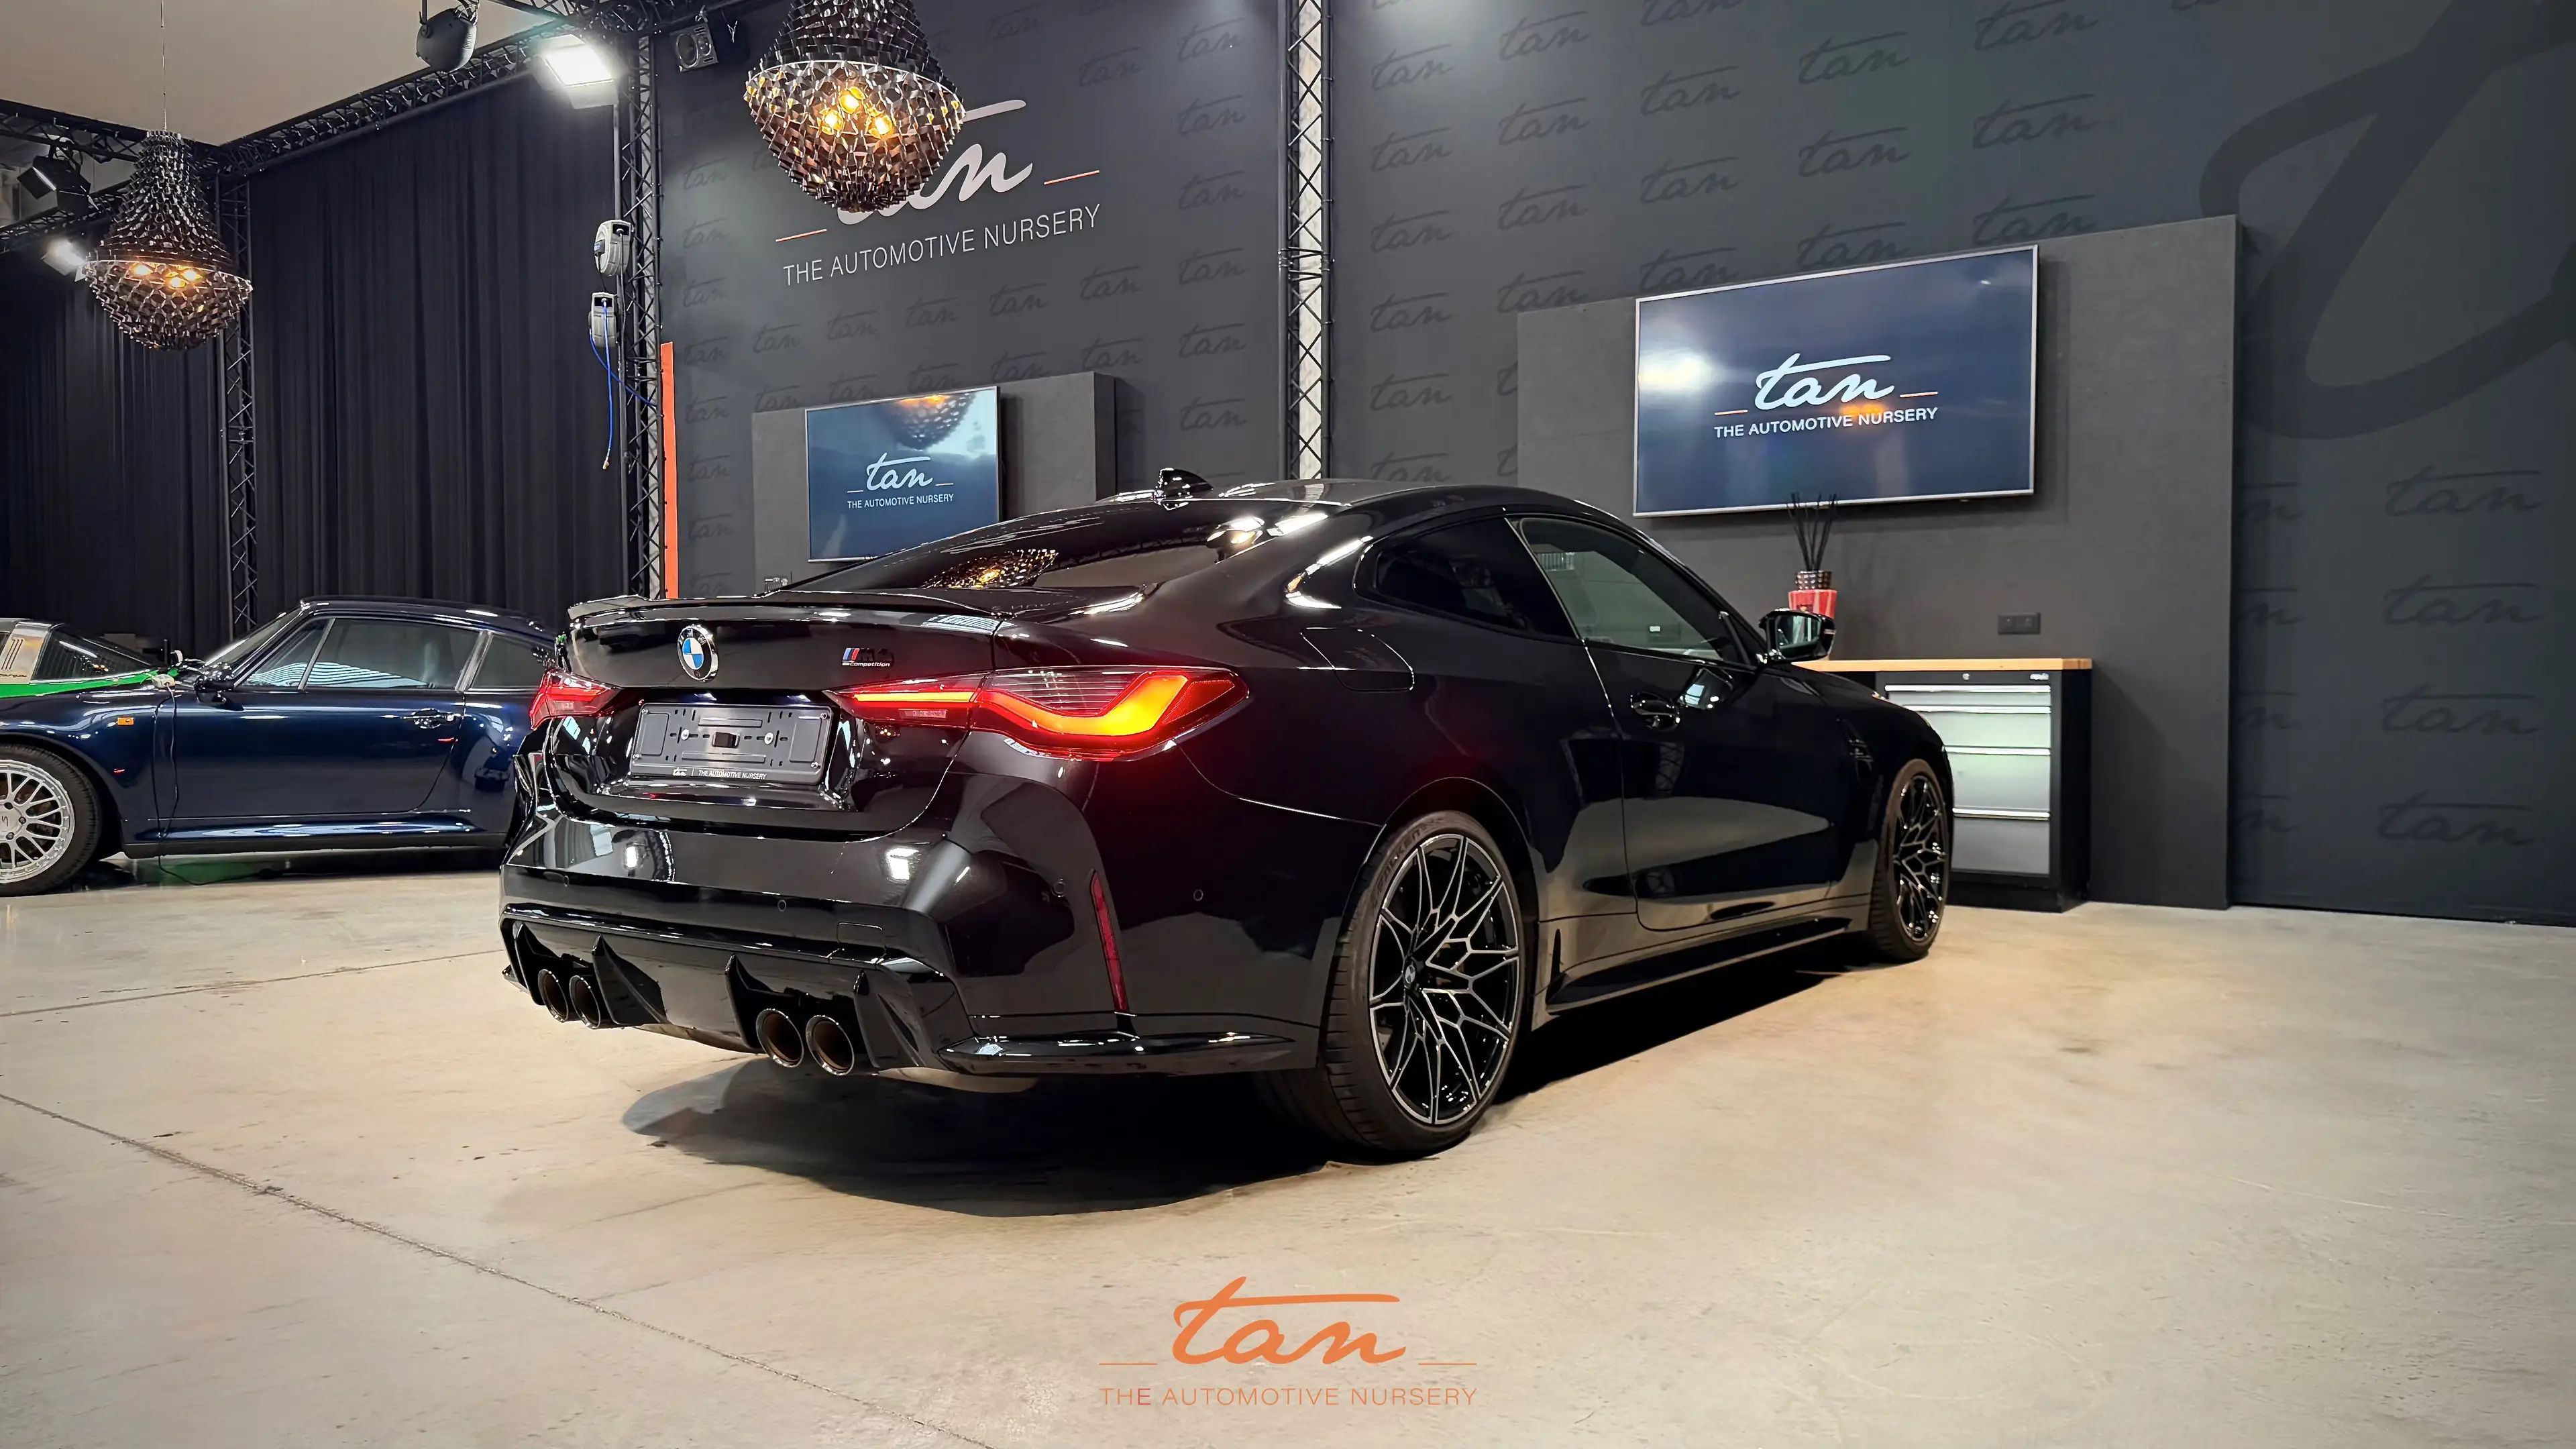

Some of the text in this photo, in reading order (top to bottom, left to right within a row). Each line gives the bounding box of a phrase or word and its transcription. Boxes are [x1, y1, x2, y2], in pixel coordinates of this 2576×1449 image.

[985, 3, 1042, 42] tan
[1177, 17, 1246, 62] tan
[1499, 10, 1591, 61] tan
[1973, 0, 2100, 51] tan
[1079, 46, 1142, 87] tan
[1371, 43, 1454, 92] tan
[1798, 31, 1911, 85] tan
[1640, 65, 1741, 116] tan
[1177, 95, 1247, 136] tan
[1499, 97, 1591, 146] tan
[1972, 93, 2100, 150] tan
[1371, 127, 1453, 172] tan
[1798, 126, 1911, 178] tan
[683, 156, 729, 191] tan
[1178, 170, 1246, 211] tan
[1640, 156, 1739, 204] tan
[1497, 184, 1589, 230] tan
[1972, 194, 2098, 246] tan
[683, 217, 729, 250] tan
[783, 203, 1100, 286] THE AUTOMOTIVE NURSERY
[1371, 210, 1453, 254] tan
[1796, 221, 1910, 269] tan
[1079, 265, 1143, 301] tan
[1178, 247, 1246, 285] tan
[1639, 247, 1739, 292] tan
[683, 276, 728, 308] tan
[989, 282, 1048, 317] tan
[1497, 270, 1589, 313] tan
[828, 309, 878, 340] tan
[906, 297, 960, 328] tan
[1371, 292, 1454, 333] tan
[684, 336, 728, 365] tan
[753, 323, 802, 353] tan
[1081, 337, 1144, 371] tan
[1178, 323, 1247, 359] tan
[828, 372, 878, 401] tan
[908, 363, 961, 394] tan
[991, 350, 1049, 382] tan
[1754, 353, 1895, 410] tan
[685, 396, 730, 424] tan
[755, 384, 800, 411] tan
[1371, 372, 1454, 411] tan
[1180, 396, 1247, 431] tan
[1714, 407, 1938, 438] THE AUTOMOTIVE NURSERY
[686, 454, 731, 482] tan
[866, 452, 933, 491] tan
[847, 493, 954, 509] THE AUTOMOTIVE NURSERY
[2384, 464, 2543, 517] tan
[2382, 574, 2543, 626] tan
[2381, 683, 2540, 735] tan
[709, 770, 741, 778] AUTOMOTIVE
[2377, 790, 2535, 846] tan
